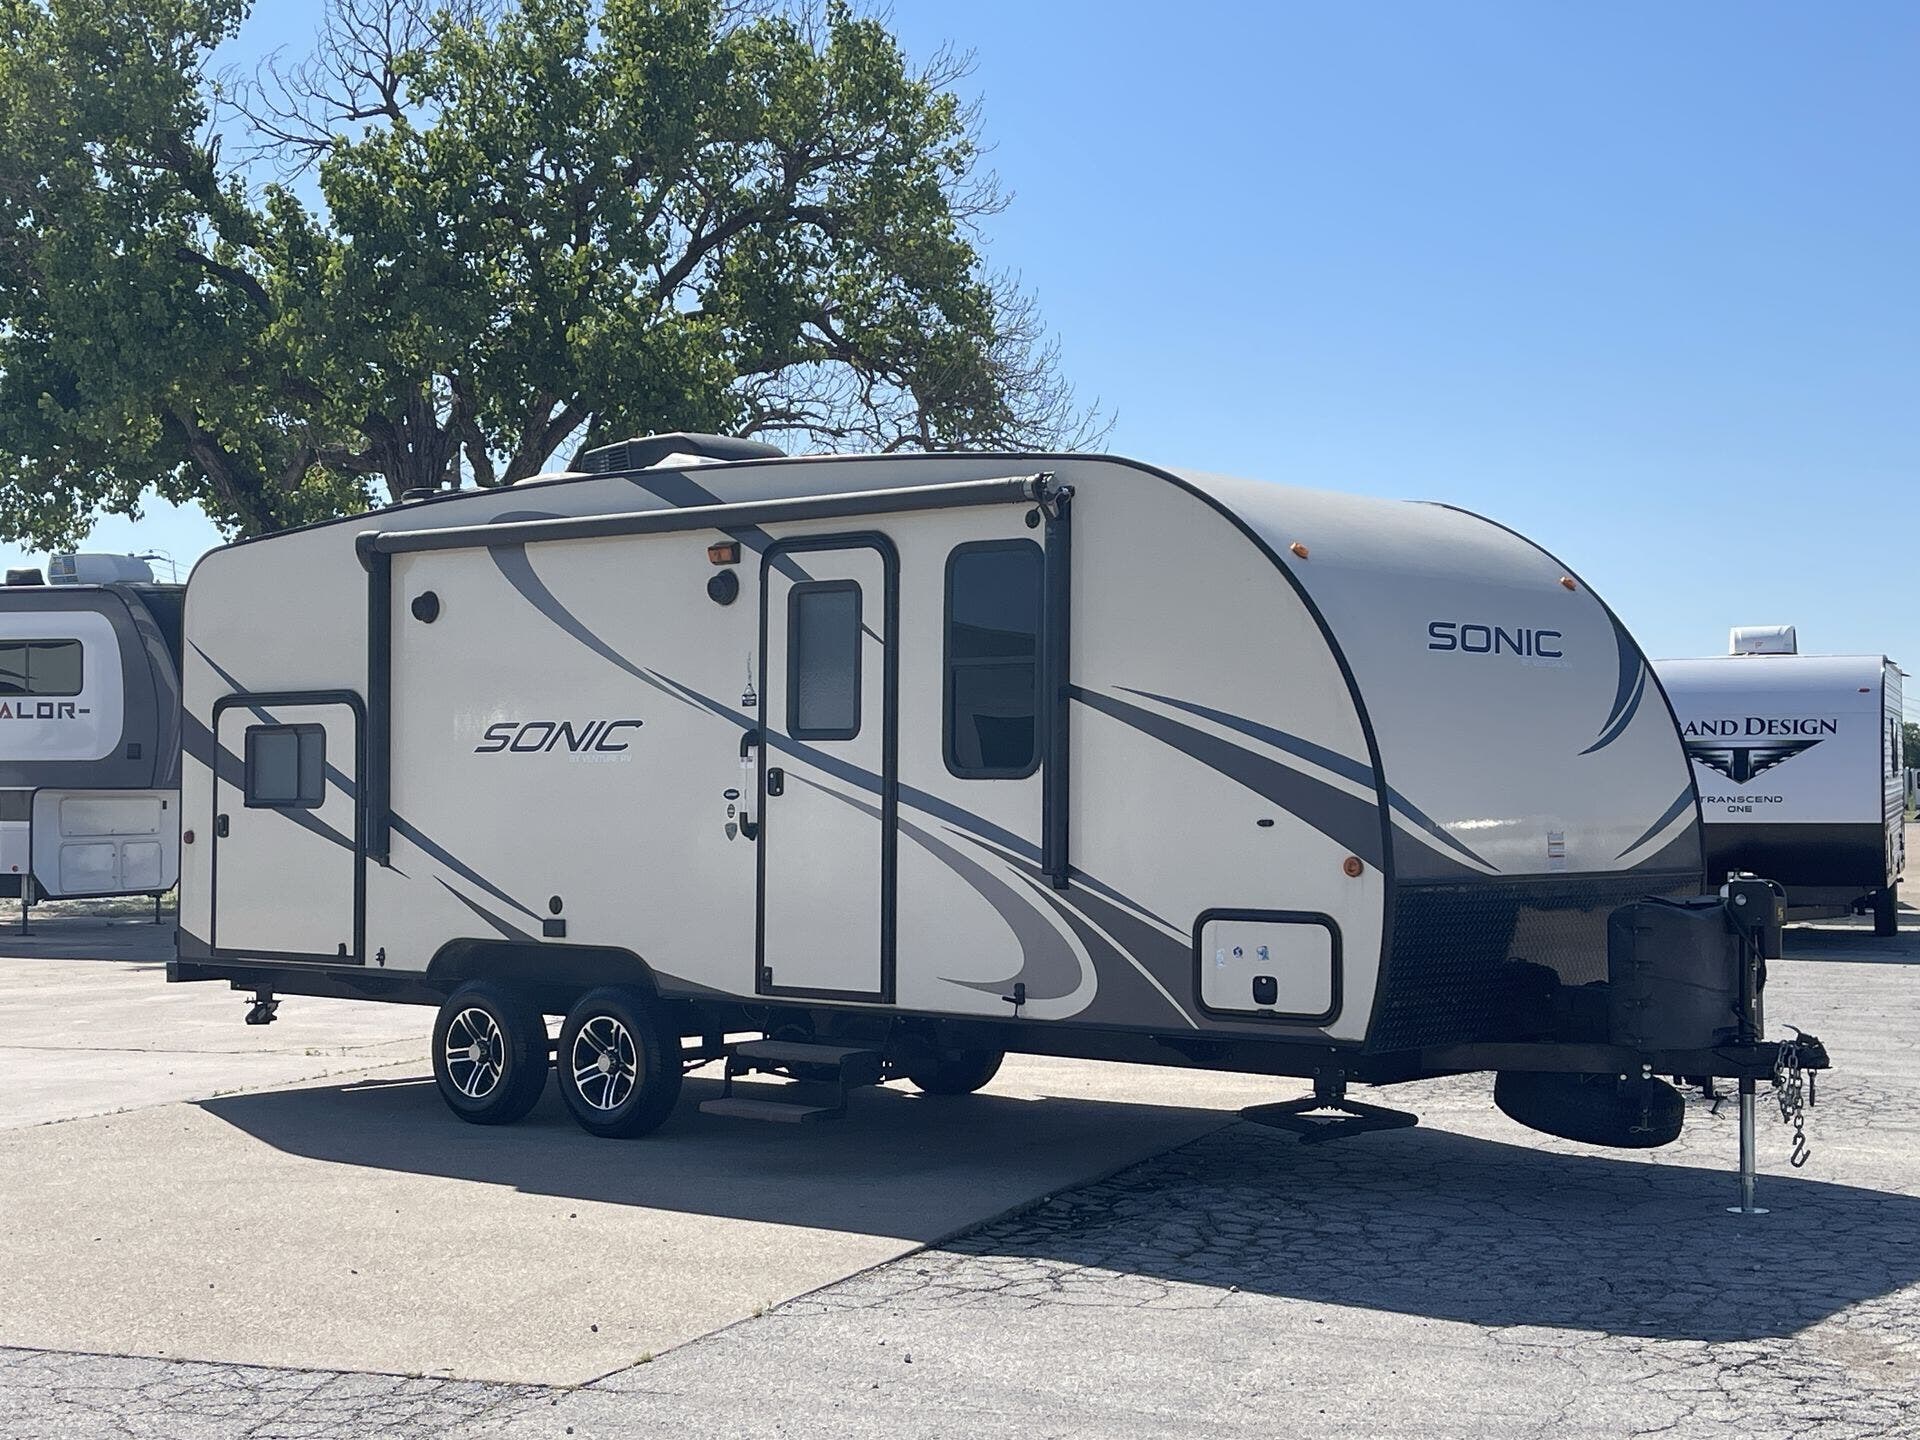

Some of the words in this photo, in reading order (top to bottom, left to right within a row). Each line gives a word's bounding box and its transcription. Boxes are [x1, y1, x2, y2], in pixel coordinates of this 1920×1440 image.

[1428, 621, 1563, 658] SONIC
[473, 719, 644, 753] SONIC
[1677, 719, 1739, 735] AND
[1727, 805, 1753, 813] ONE
